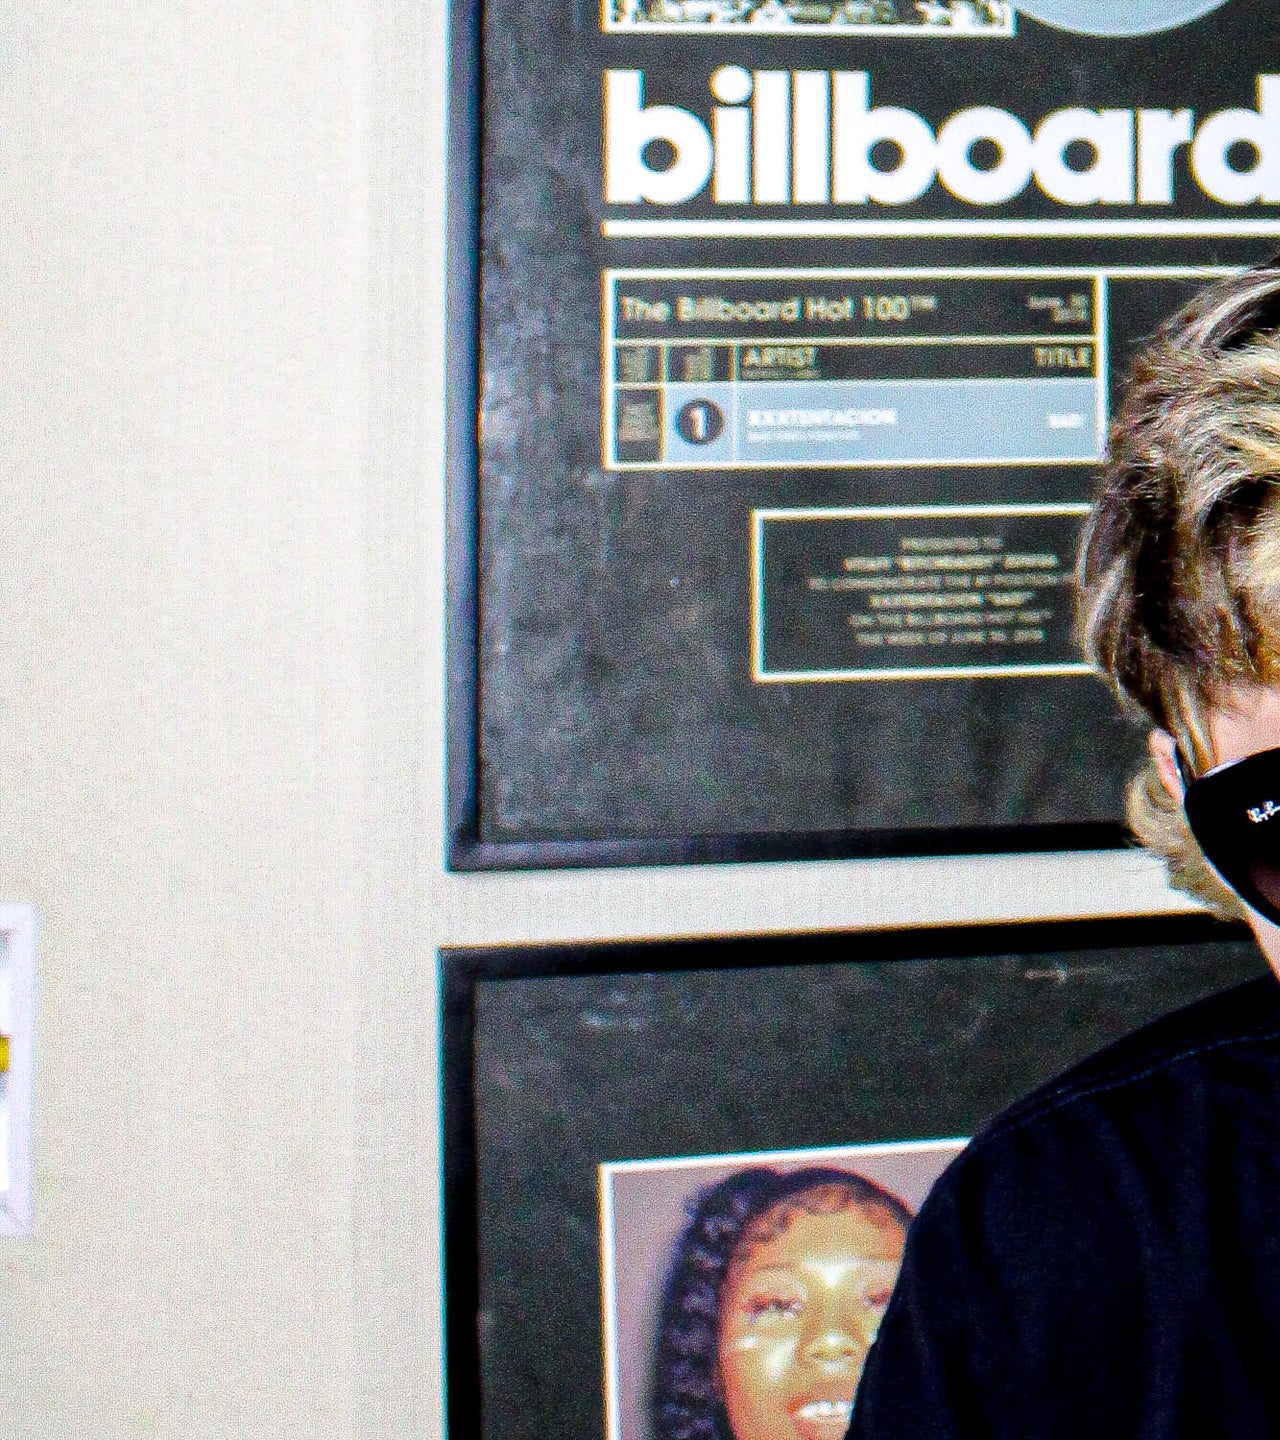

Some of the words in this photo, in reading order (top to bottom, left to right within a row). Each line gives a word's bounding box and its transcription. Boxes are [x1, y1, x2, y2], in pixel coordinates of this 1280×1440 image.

[620, 297, 668, 322] The
[676, 295, 800, 323] Billboard
[805, 295, 855, 322] Hot
[742, 347, 820, 369] ARTIST
[1033, 346, 1093, 369] TITLE
[690, 408, 709, 439] 1
